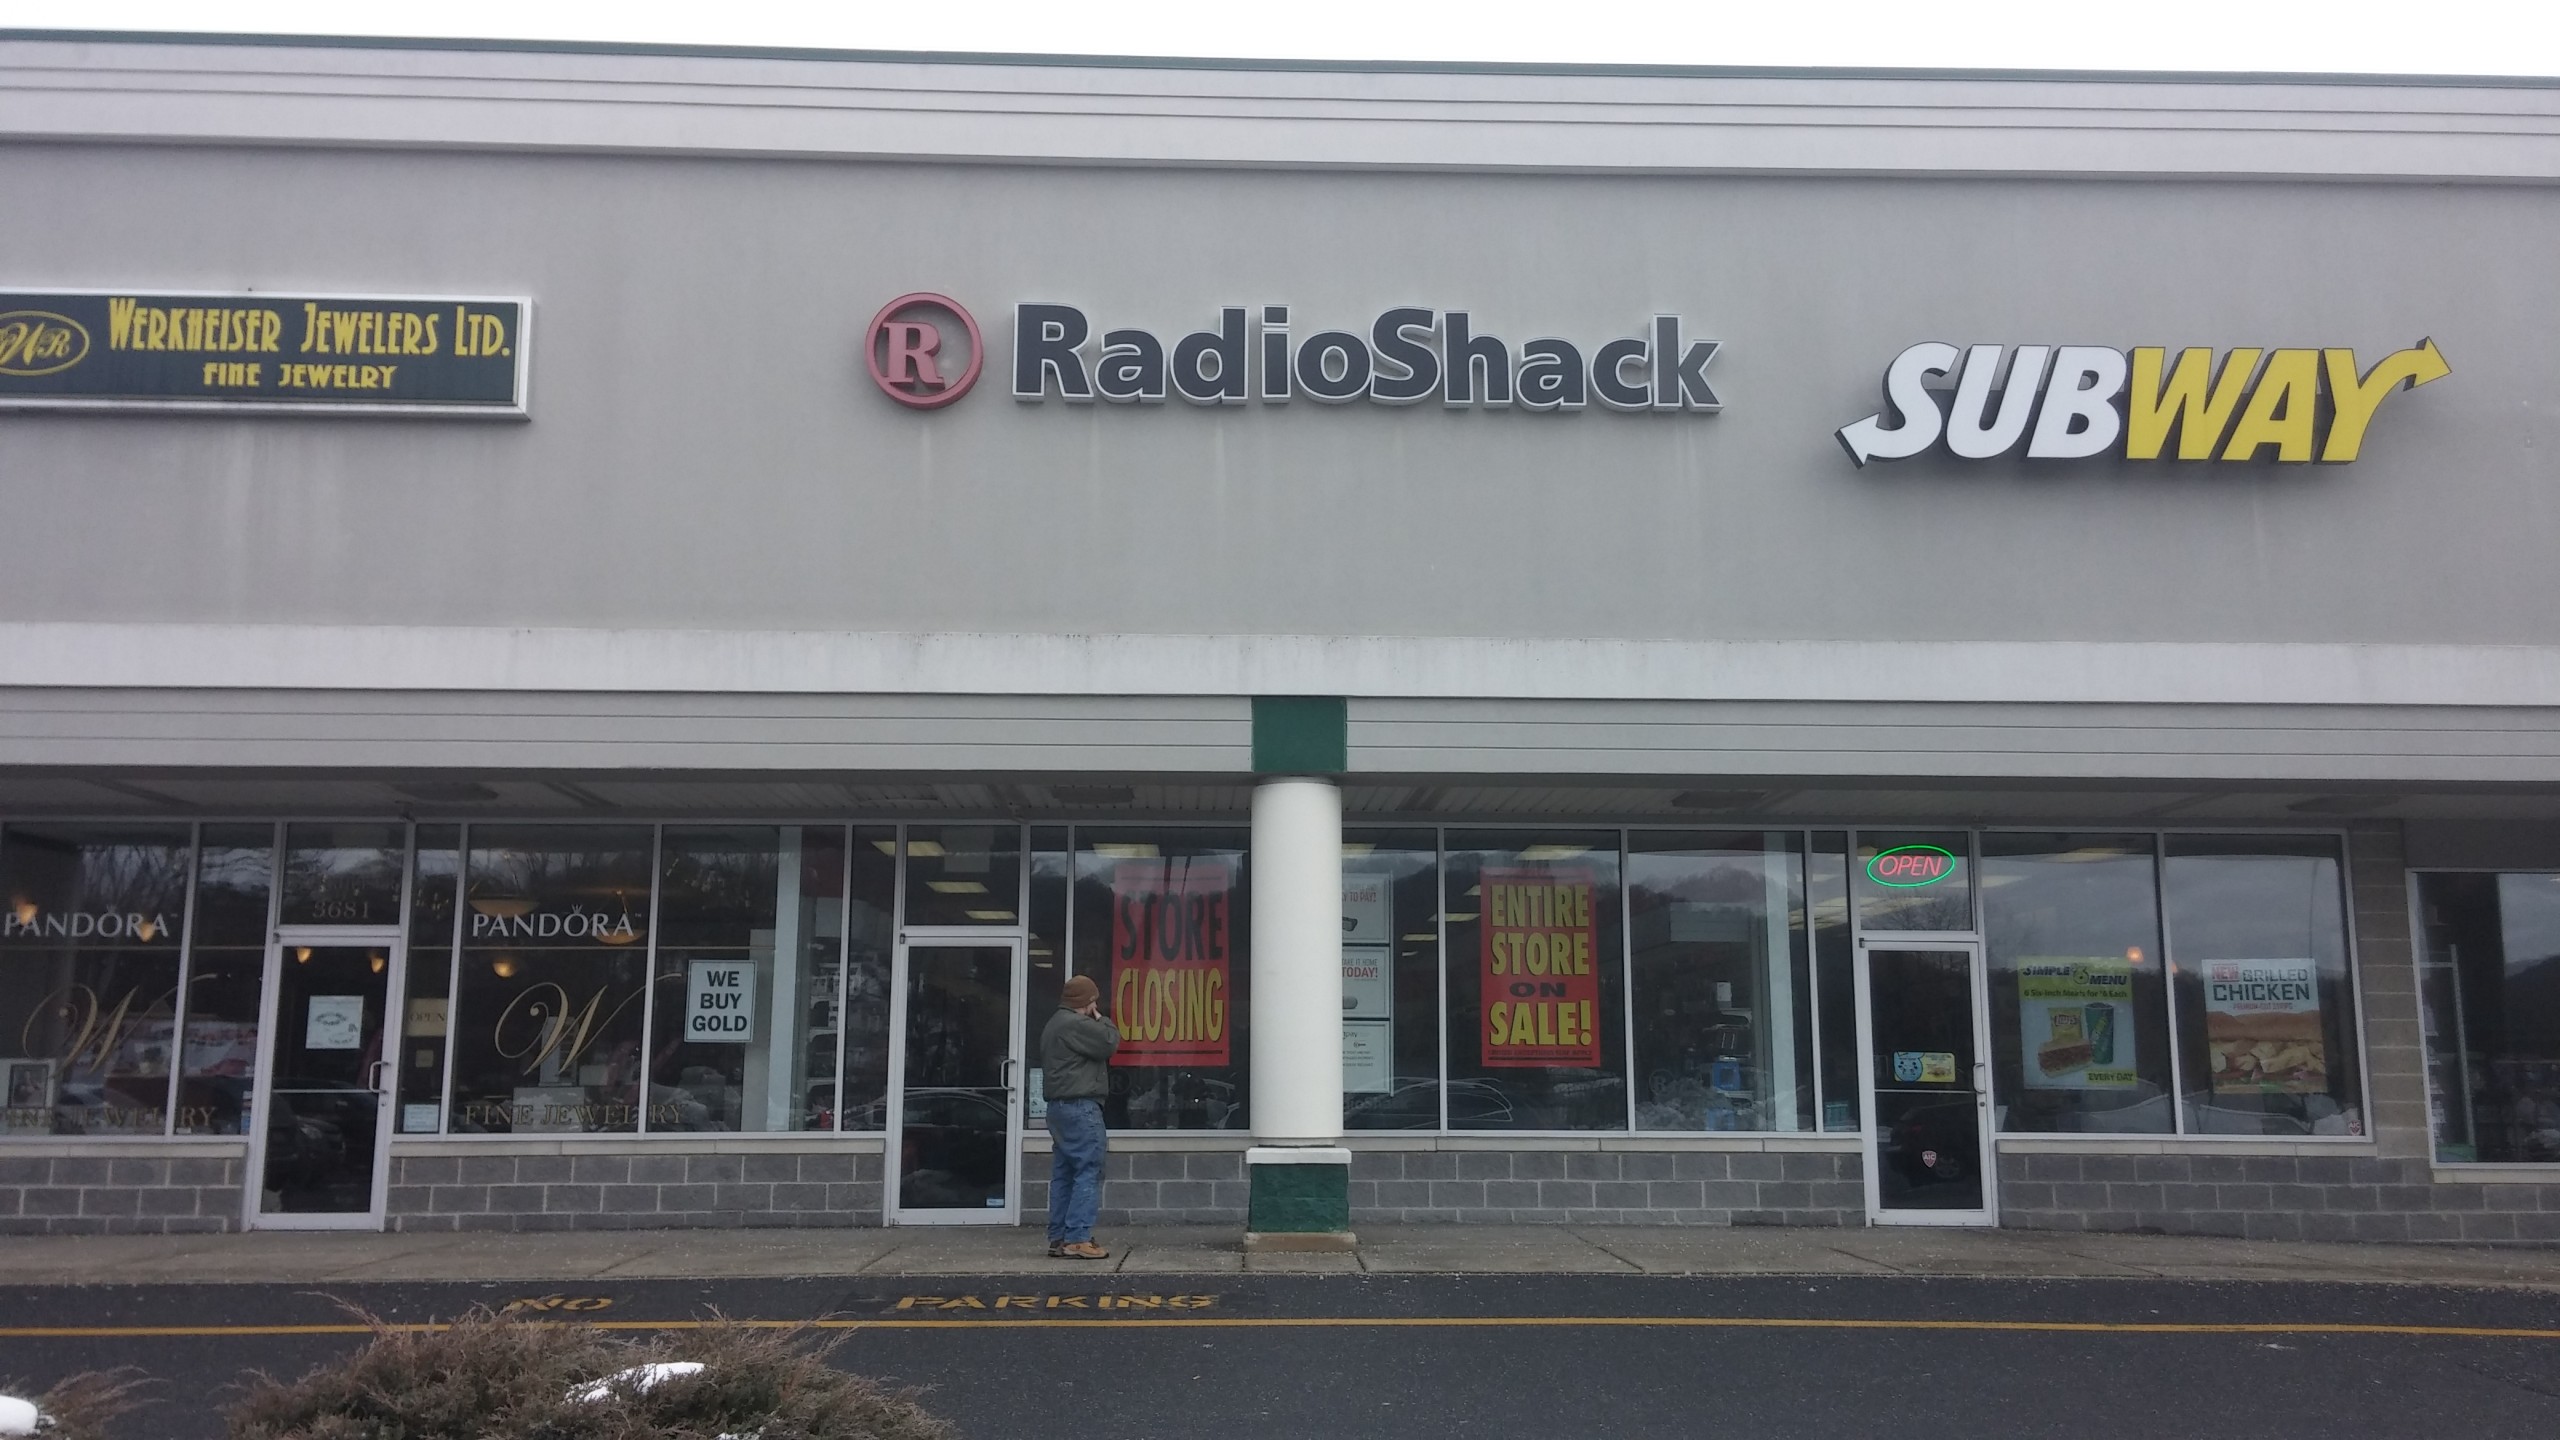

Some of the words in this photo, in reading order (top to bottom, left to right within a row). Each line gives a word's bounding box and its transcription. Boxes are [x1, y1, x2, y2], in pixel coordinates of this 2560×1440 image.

[109, 297, 281, 352] WERKHEISER
[301, 302, 439, 355] JEWELERS
[454, 305, 511, 357] LTD.
[1012, 302, 1724, 413] RadioShack
[203, 362, 262, 387] FINE
[278, 363, 398, 390] JEWELRY
[1835, 336, 2452, 469] SUBWAY
[1878, 855, 1943, 876] OPEN
[312, 901, 370, 919] 3681
[1490, 884, 1590, 928] ENTIRE
[4, 912, 169, 938] PANDORA
[471, 912, 635, 938] PANDORA
[1120, 889, 1224, 962] STORE
[1490, 932, 1590, 976] STORE
[706, 970, 740, 987] WE
[2023, 965, 2071, 976] SIMPLE
[2089, 975, 2128, 987] MENU
[2242, 968, 2309, 982] GRILLED
[1509, 982, 1567, 997] ON
[2212, 983, 2310, 1001] CHICKEN
[699, 993, 743, 1010] BUY
[1116, 967, 1224, 1042] CLOSING
[409, 1012, 446, 1022] OPEN
[692, 1014, 748, 1032] GOLD
[1489, 1000, 1593, 1046] SALE!
[464, 1104, 535, 1126] FINE
[539, 1103, 683, 1126] JEWELRY
[500, 1298, 612, 1311] NO
[896, 1295, 1219, 1309] PARKING
